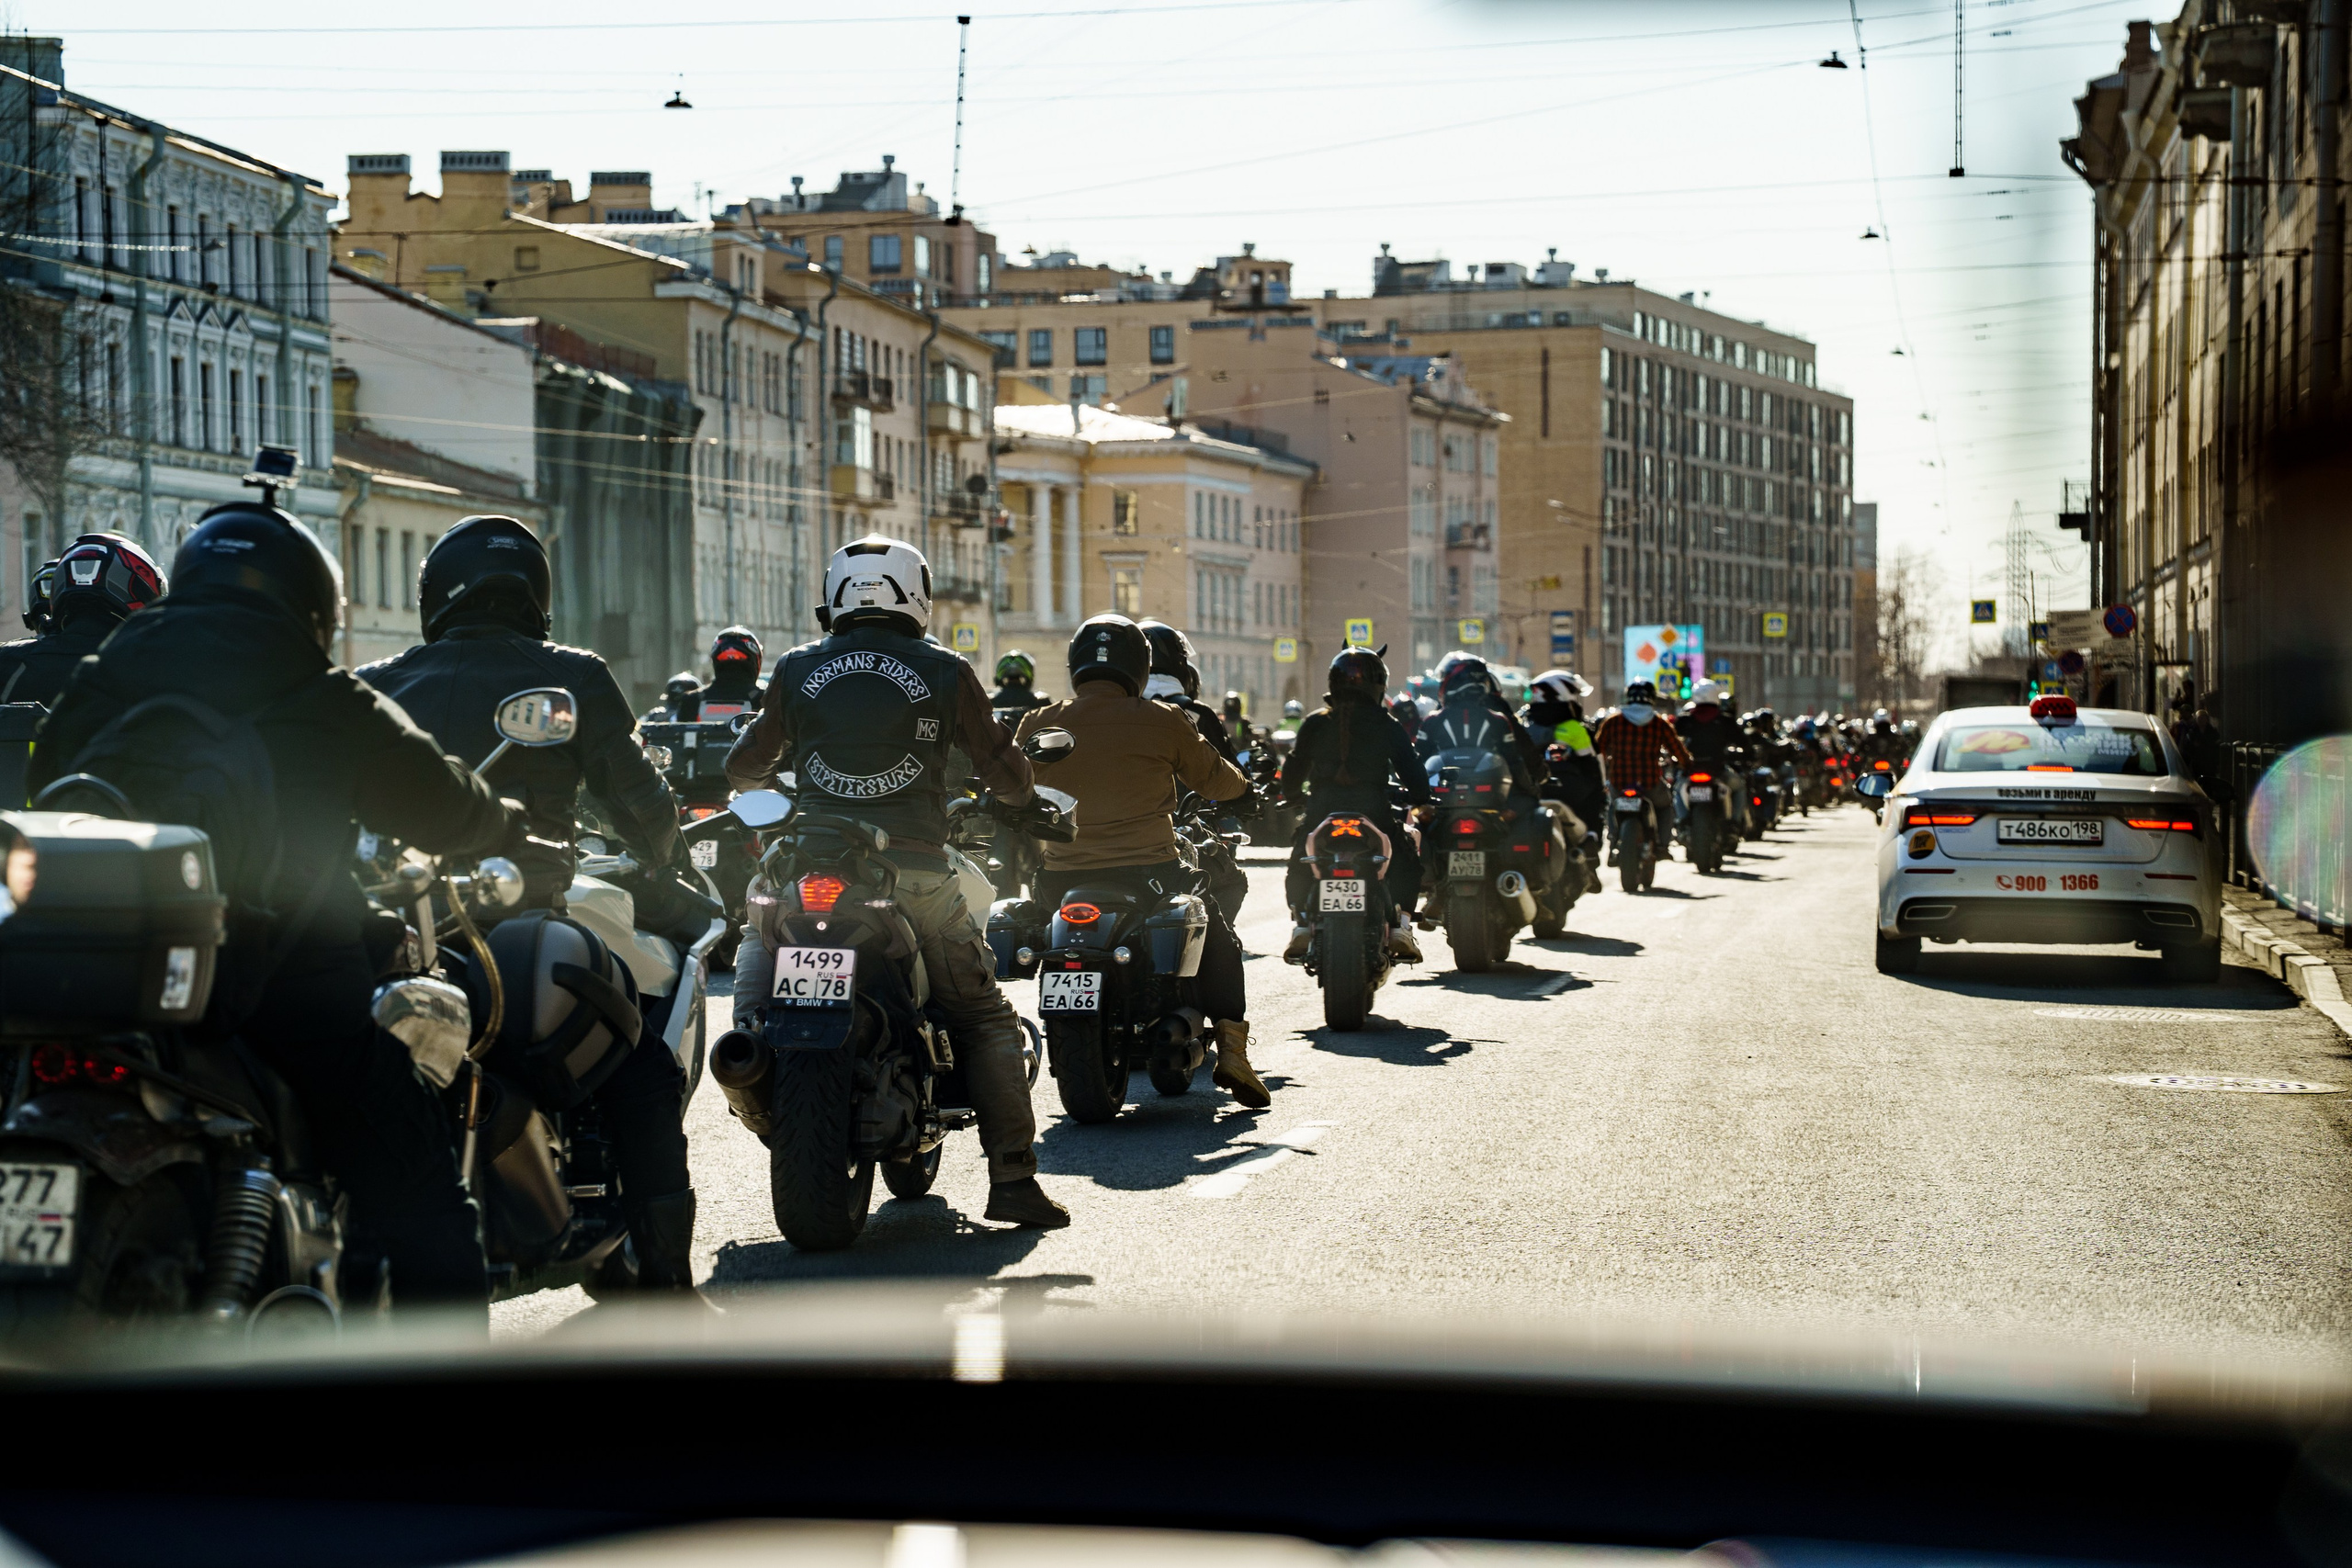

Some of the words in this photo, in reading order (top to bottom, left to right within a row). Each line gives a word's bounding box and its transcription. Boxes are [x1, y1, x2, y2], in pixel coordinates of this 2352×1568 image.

[805, 653, 876, 694] NORMANS
[878, 657, 925, 697] RIDERS
[919, 721, 937, 739] MC
[2044, 789, 2052, 799] в
[2053, 789, 2097, 801] аренду
[2073, 822, 2098, 835] 198
[1326, 881, 1359, 893] 5430
[2015, 875, 2046, 892] 900
[2059, 874, 2099, 891] 1366
[1346, 898, 1363, 909] 66
[790, 950, 843, 969] 1499
[820, 979, 845, 997] 78
[1051, 974, 1093, 988] 7415
[796, 998, 822, 1007] BMW
[1074, 995, 1094, 1009] 66
[17, 1224, 63, 1258] 47
